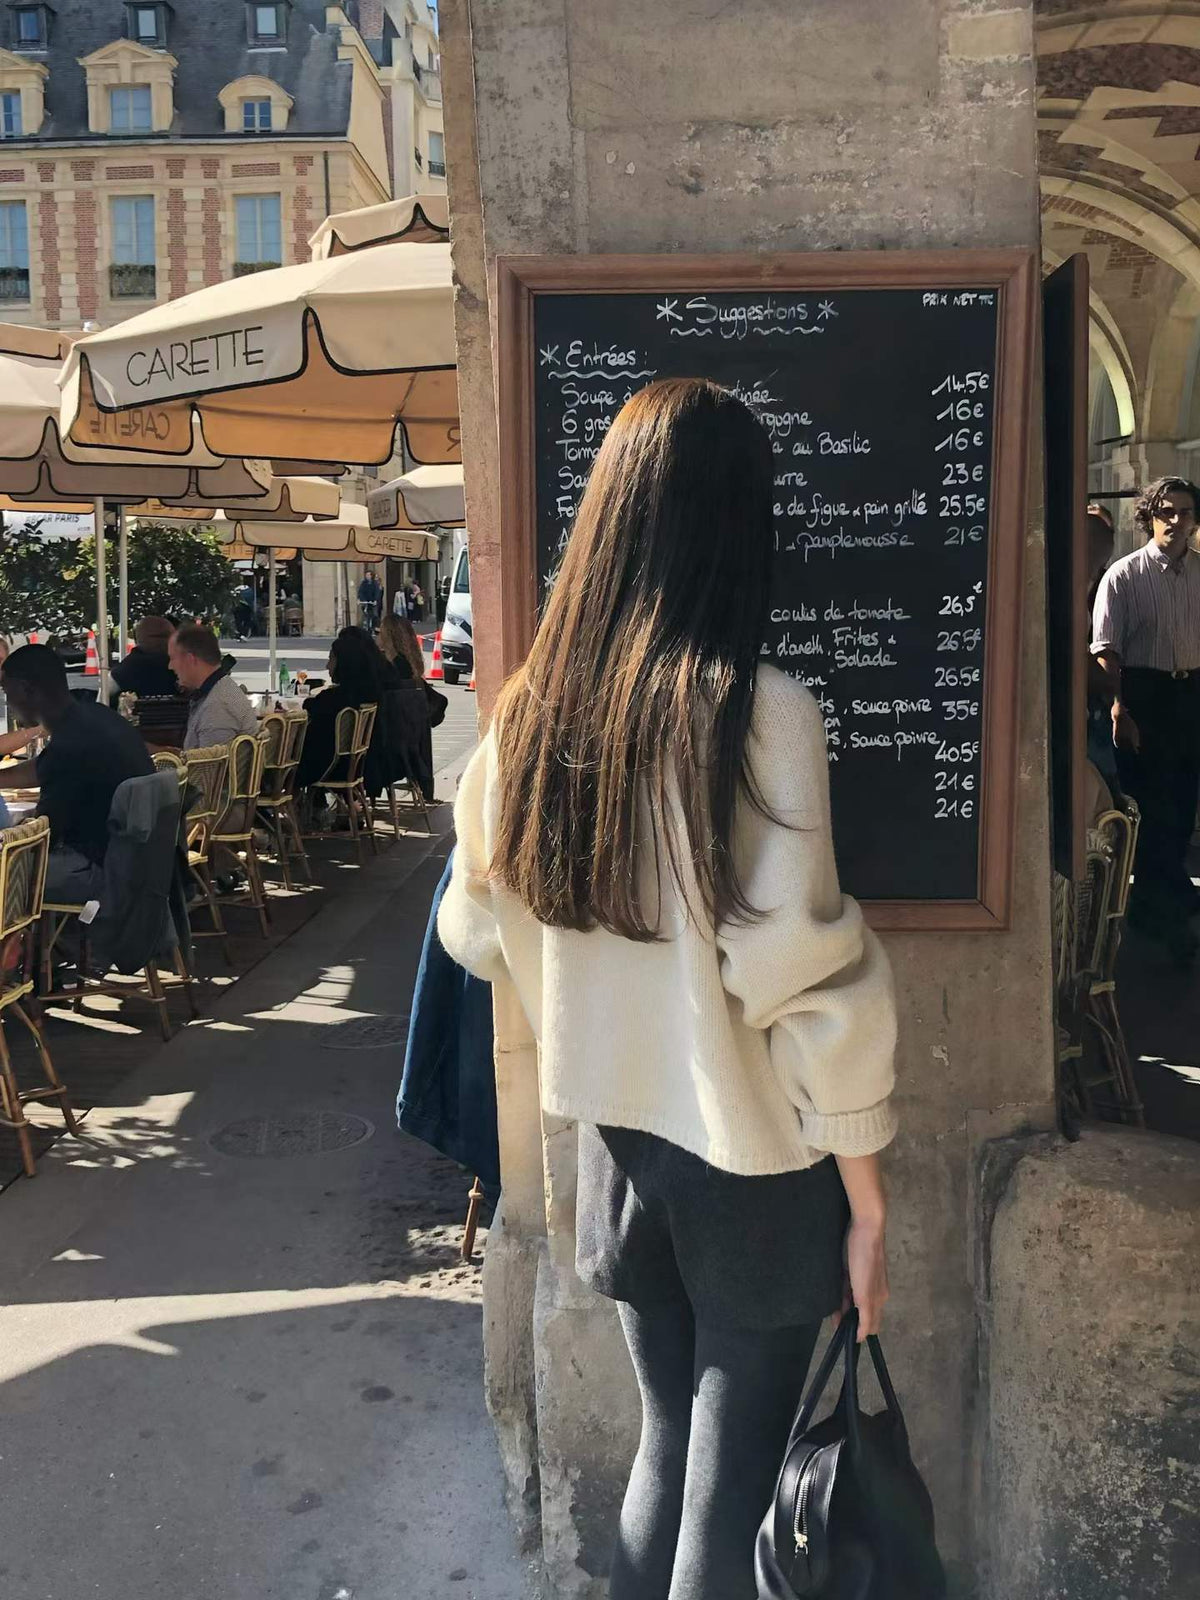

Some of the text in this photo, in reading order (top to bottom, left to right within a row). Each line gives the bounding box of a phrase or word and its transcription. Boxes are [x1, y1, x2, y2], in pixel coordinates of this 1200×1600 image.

[686, 297, 809, 340] Suggestions
[126, 326, 264, 387] CARETTE
[560, 382, 617, 413] Soupe
[561, 408, 578, 435] 6
[936, 399, 985, 421] 16€
[760, 411, 813, 439] rgogne
[816, 430, 872, 455] Basilic
[935, 428, 984, 452] 16€
[942, 463, 984, 486] 23€
[806, 492, 851, 528] figue
[890, 489, 928, 527] grillé
[938, 494, 986, 517] 25.5€
[367, 535, 413, 554] CARETTE
[796, 526, 915, 563] pamplemousse
[943, 525, 984, 546] 21€
[770, 598, 912, 623] coulis de tomate
[832, 626, 880, 647] Frites
[834, 648, 898, 669] Salade
[934, 666, 980, 688] 26.5€
[892, 698, 933, 724] poivre
[941, 700, 979, 721] 35€
[893, 731, 942, 762] poivre
[934, 771, 975, 792] 21€
[934, 798, 974, 819] 21€
